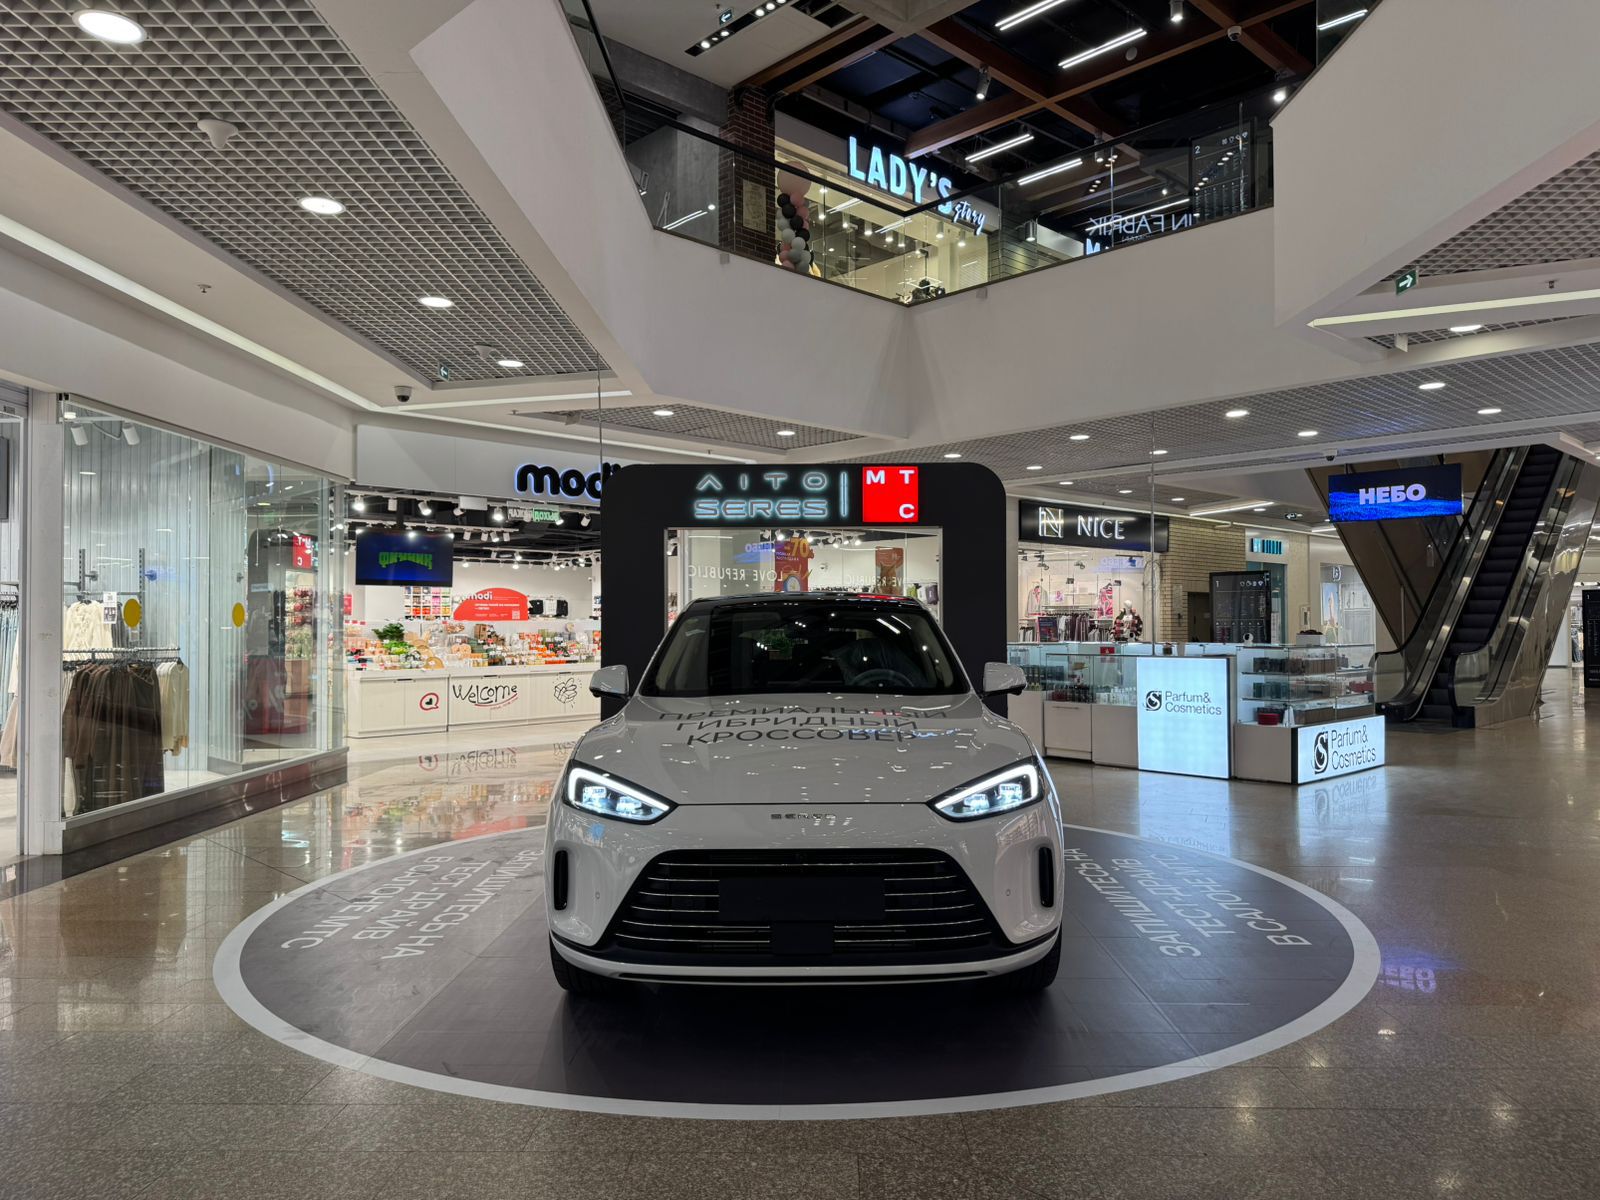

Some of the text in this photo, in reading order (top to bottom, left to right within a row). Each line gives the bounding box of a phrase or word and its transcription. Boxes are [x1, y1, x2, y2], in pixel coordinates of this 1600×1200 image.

[849, 136, 952, 214] LADY'S
[954, 201, 986, 235] story
[516, 464, 621, 499] mod
[1359, 483, 1426, 505] НЕБО
[694, 499, 828, 518] SERES
[1077, 515, 1125, 540] NICE
[1165, 691, 1211, 703] Parfum&
[1165, 701, 1222, 715] Cosmetics
[676, 715, 918, 731] ГИБРИДНЫЙ
[687, 728, 918, 746] КРОССОВЕР
[1331, 724, 1368, 749] Parfum&
[1331, 745, 1376, 770] Cosmetics
[352, 859, 491, 940] ТЕСТ-ДРАЙВ
[381, 849, 544, 959] ЗАПИШИТЕСЬ НА
[1074, 862, 1201, 957] ЗАПИШИТЕСЬ
[1112, 857, 1236, 938] ТЕСТ-ДРАЙВ
[280, 915, 361, 949] МТС
